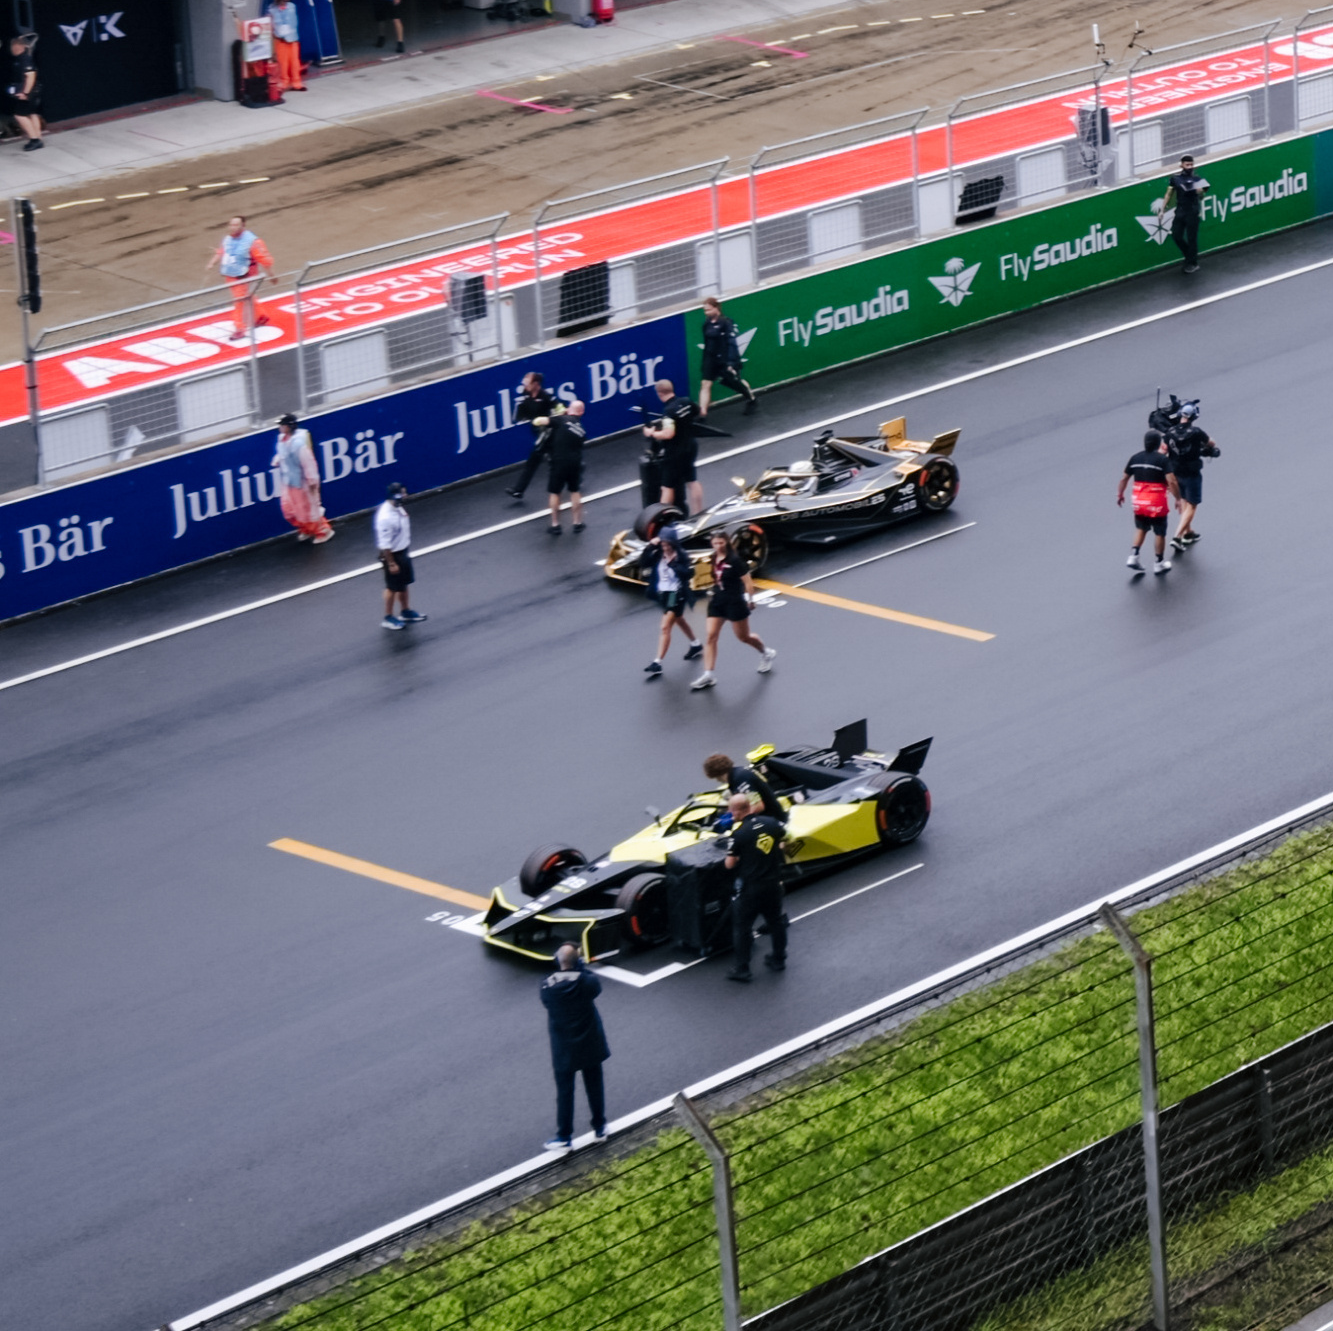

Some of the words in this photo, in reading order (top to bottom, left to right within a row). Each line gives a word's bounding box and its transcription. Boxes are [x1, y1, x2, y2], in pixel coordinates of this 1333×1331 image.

[279, 232, 583, 314] ENGINEERED
[588, 353, 664, 403] Bär
[169, 465, 282, 540] Juliu
[319, 429, 404, 483] Bär
[19, 514, 114, 573] Bär
